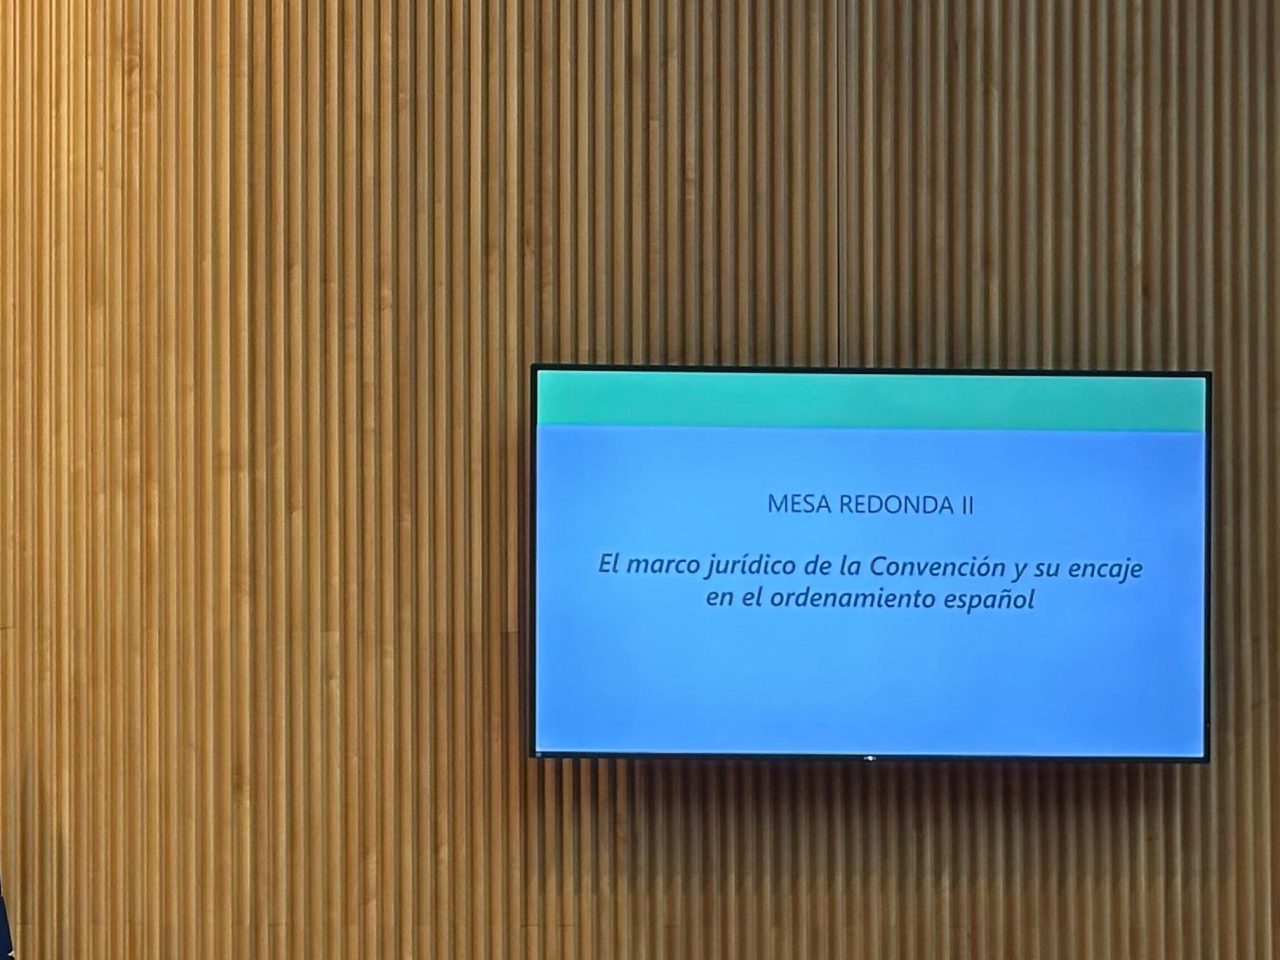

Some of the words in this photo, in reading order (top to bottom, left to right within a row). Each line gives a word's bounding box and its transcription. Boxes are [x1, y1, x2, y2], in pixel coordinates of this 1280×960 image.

[769, 493, 832, 513] MESA
[840, 494, 954, 514] REDONDA
[962, 496, 973, 514] II
[598, 553, 620, 573] El
[626, 558, 700, 574] marco
[703, 553, 796, 580] jurídico
[804, 554, 832, 575] de
[840, 554, 862, 576] la
[870, 555, 1006, 577] Convención
[1011, 562, 1028, 583] y
[1034, 562, 1060, 577] su
[1068, 557, 1144, 584] encaje
[706, 590, 734, 606] en
[742, 586, 763, 607] el
[770, 586, 936, 609] ordenamiento
[944, 588, 1036, 614] español
